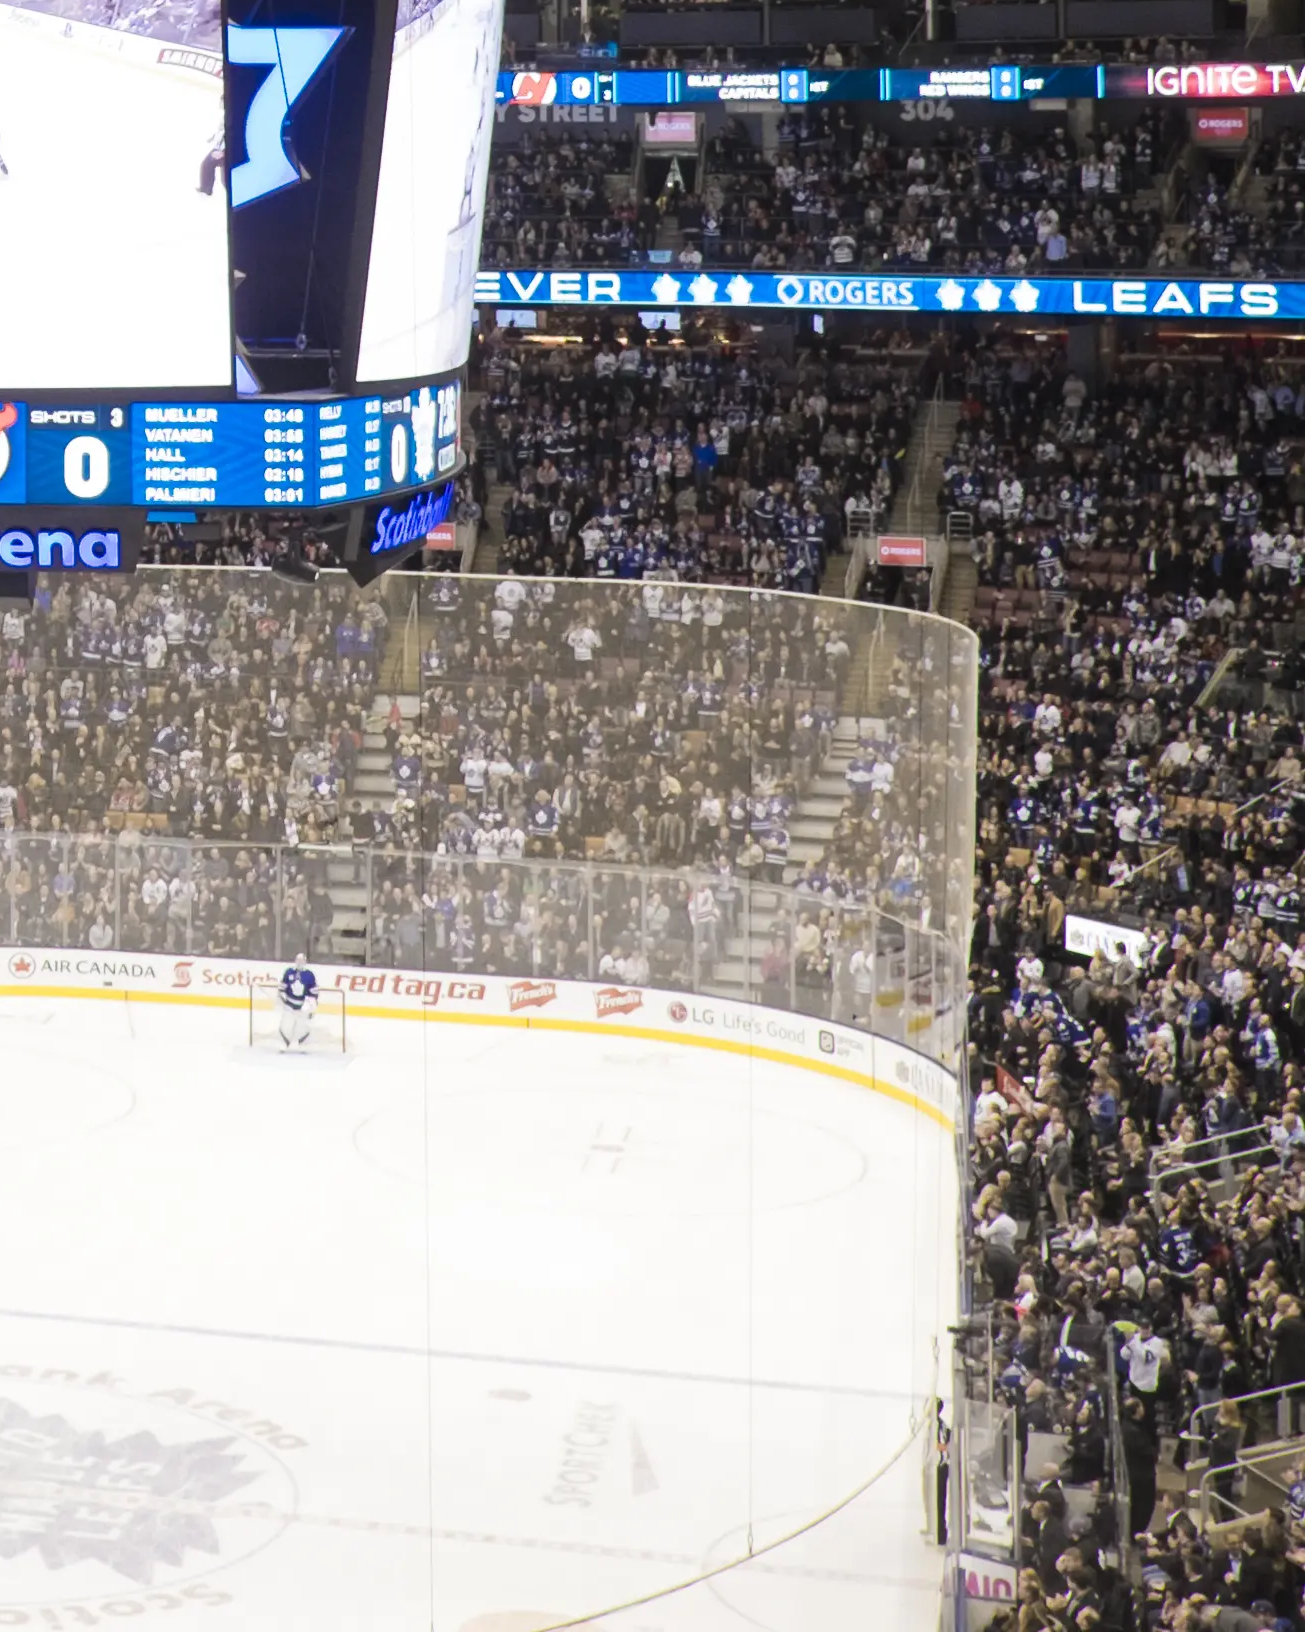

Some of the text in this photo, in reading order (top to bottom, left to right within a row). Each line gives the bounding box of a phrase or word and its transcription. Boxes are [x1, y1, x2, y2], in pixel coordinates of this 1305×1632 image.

[570, 76, 592, 100] 0
[517, 103, 619, 123] STREET
[899, 99, 955, 122] 304
[1208, 119, 1243, 129] ROGERS
[807, 279, 914, 306] ROGERS
[1072, 280, 1280, 316] LEAFS
[30, 409, 124, 428] SHOTS 3
[145, 407, 219, 423] MUELLER
[144, 428, 214, 443] VATANEN
[145, 447, 187, 462] HALL
[263, 448, 305, 463] 03:14
[390, 423, 407, 484] 0
[63, 435, 110, 499] 0
[145, 466, 218, 482] HISCHIER
[145, 486, 216, 502] PALMIERI
[40, 958, 157, 979] AIR CANADA
[692, 1008, 806, 1045] LG Life's Good
[146, 1385, 312, 1453] Arena
